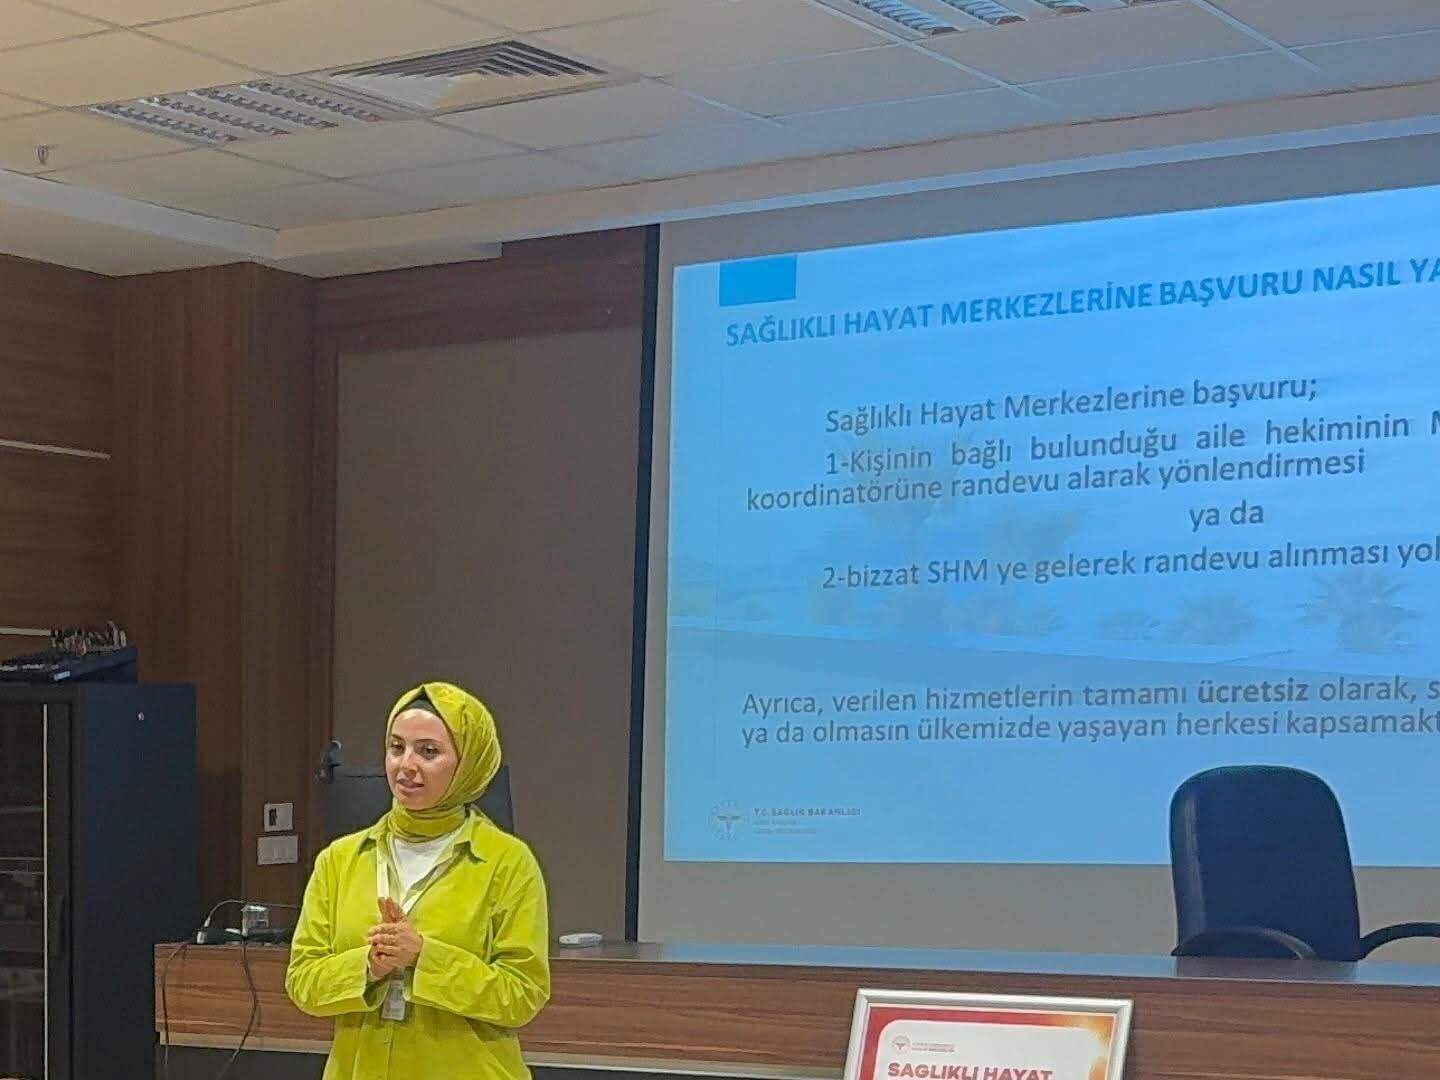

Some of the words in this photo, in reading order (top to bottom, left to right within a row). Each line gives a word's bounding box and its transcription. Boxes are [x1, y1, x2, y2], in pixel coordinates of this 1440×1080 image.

[726, 314, 835, 347] SAĞLIKLI
[844, 304, 934, 335] HAYAT
[941, 281, 1152, 322] MERKEZLERİNE
[1159, 270, 1303, 307] BAŞVURU
[1313, 261, 1400, 292] NASIL
[825, 402, 911, 436] Sağlıklı
[921, 399, 996, 429] Hayat
[1004, 385, 1185, 418] Merkezlerine
[1193, 378, 1317, 408] başvuru;
[825, 449, 932, 476] 1-Kişinin
[951, 439, 1011, 469] bağlı
[1031, 427, 1177, 461] bulunduğu
[1196, 422, 1246, 449] aile
[1265, 413, 1409, 445] hekiminin
[747, 478, 942, 512] koordinatörüne
[951, 470, 1059, 497] randevu
[1067, 461, 1151, 490] alarak
[1159, 448, 1365, 490] yönlendirmesi
[1189, 506, 1220, 532] ya
[1229, 499, 1264, 526] da
[822, 564, 919, 590] 2-bizzat
[927, 558, 988, 584] SHM
[997, 560, 1027, 586] ye
[1034, 549, 1136, 584] gelerek
[1143, 546, 1259, 575] randevu
[1268, 542, 1388, 569] alınması
[742, 693, 824, 720] Ayrıca,
[832, 688, 917, 713] verilen
[926, 684, 1073, 710] hizmetlerin
[1083, 684, 1187, 707] tamamı
[1198, 677, 1310, 704] ücretsiz
[1319, 675, 1417, 704] olarak,
[741, 725, 768, 748] ya
[776, 720, 805, 745] da
[813, 719, 909, 743] olmasın
[917, 714, 1050, 742] ülkemizde
[1058, 716, 1166, 743] yaşayan
[1176, 710, 1278, 737] herkesi
